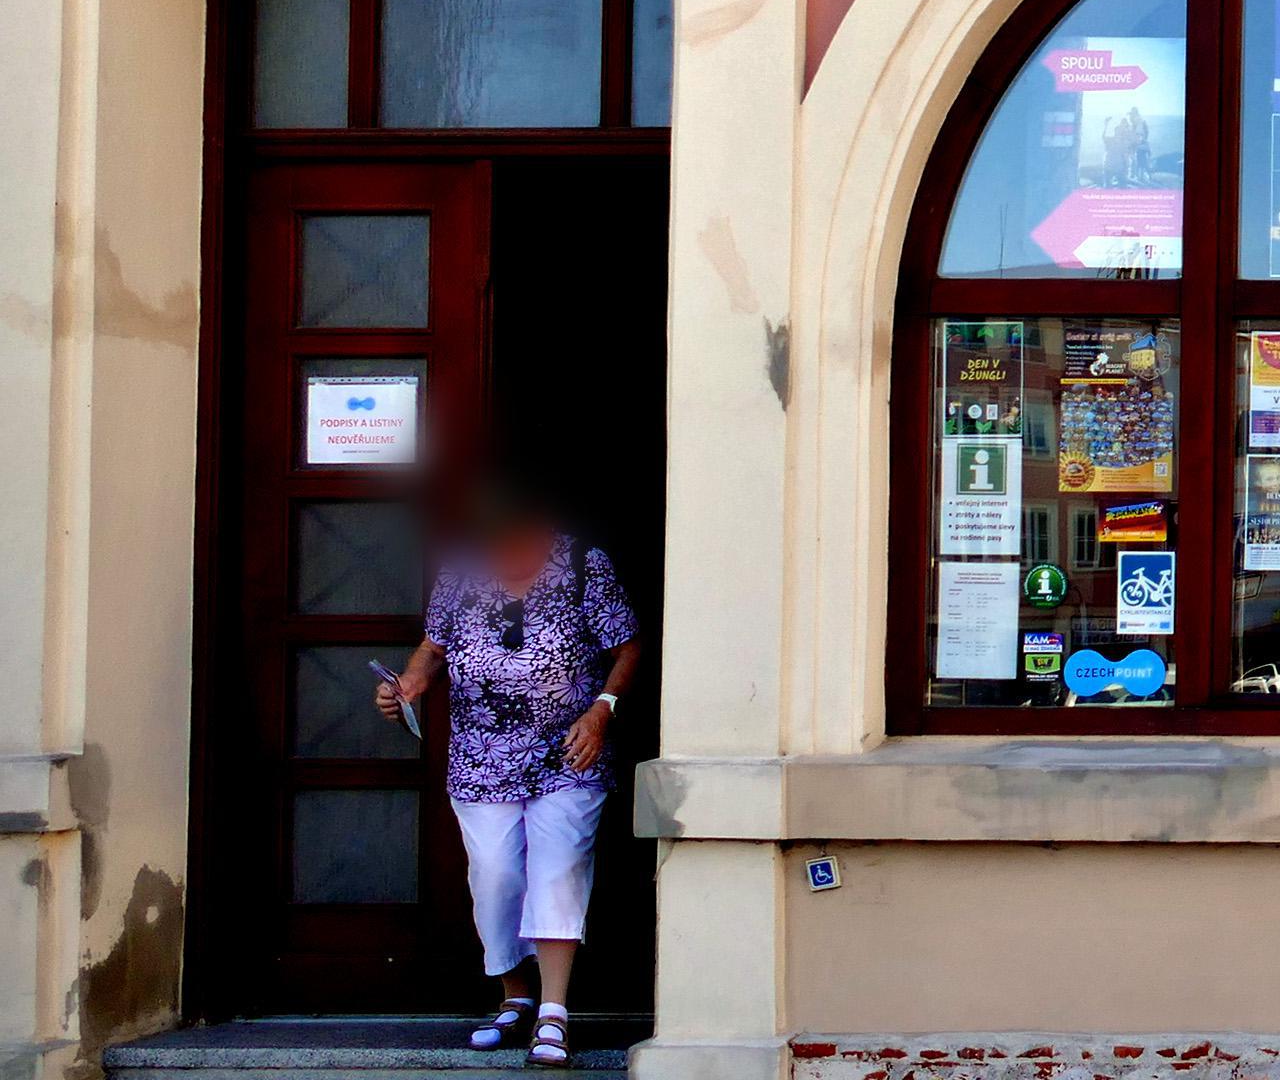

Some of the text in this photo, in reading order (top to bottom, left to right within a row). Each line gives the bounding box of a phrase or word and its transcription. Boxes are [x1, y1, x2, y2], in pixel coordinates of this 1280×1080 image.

[1061, 56, 1104, 70] SPOLU
[1061, 73, 1075, 83] PO
[967, 359, 1000, 369] DEN V
[960, 369, 1006, 380] DŽUNGLI
[320, 419, 404, 428] PODPISY A LISTINY
[327, 433, 396, 445] NEOVĚŘUJEME
[1024, 635, 1049, 645] KAM
